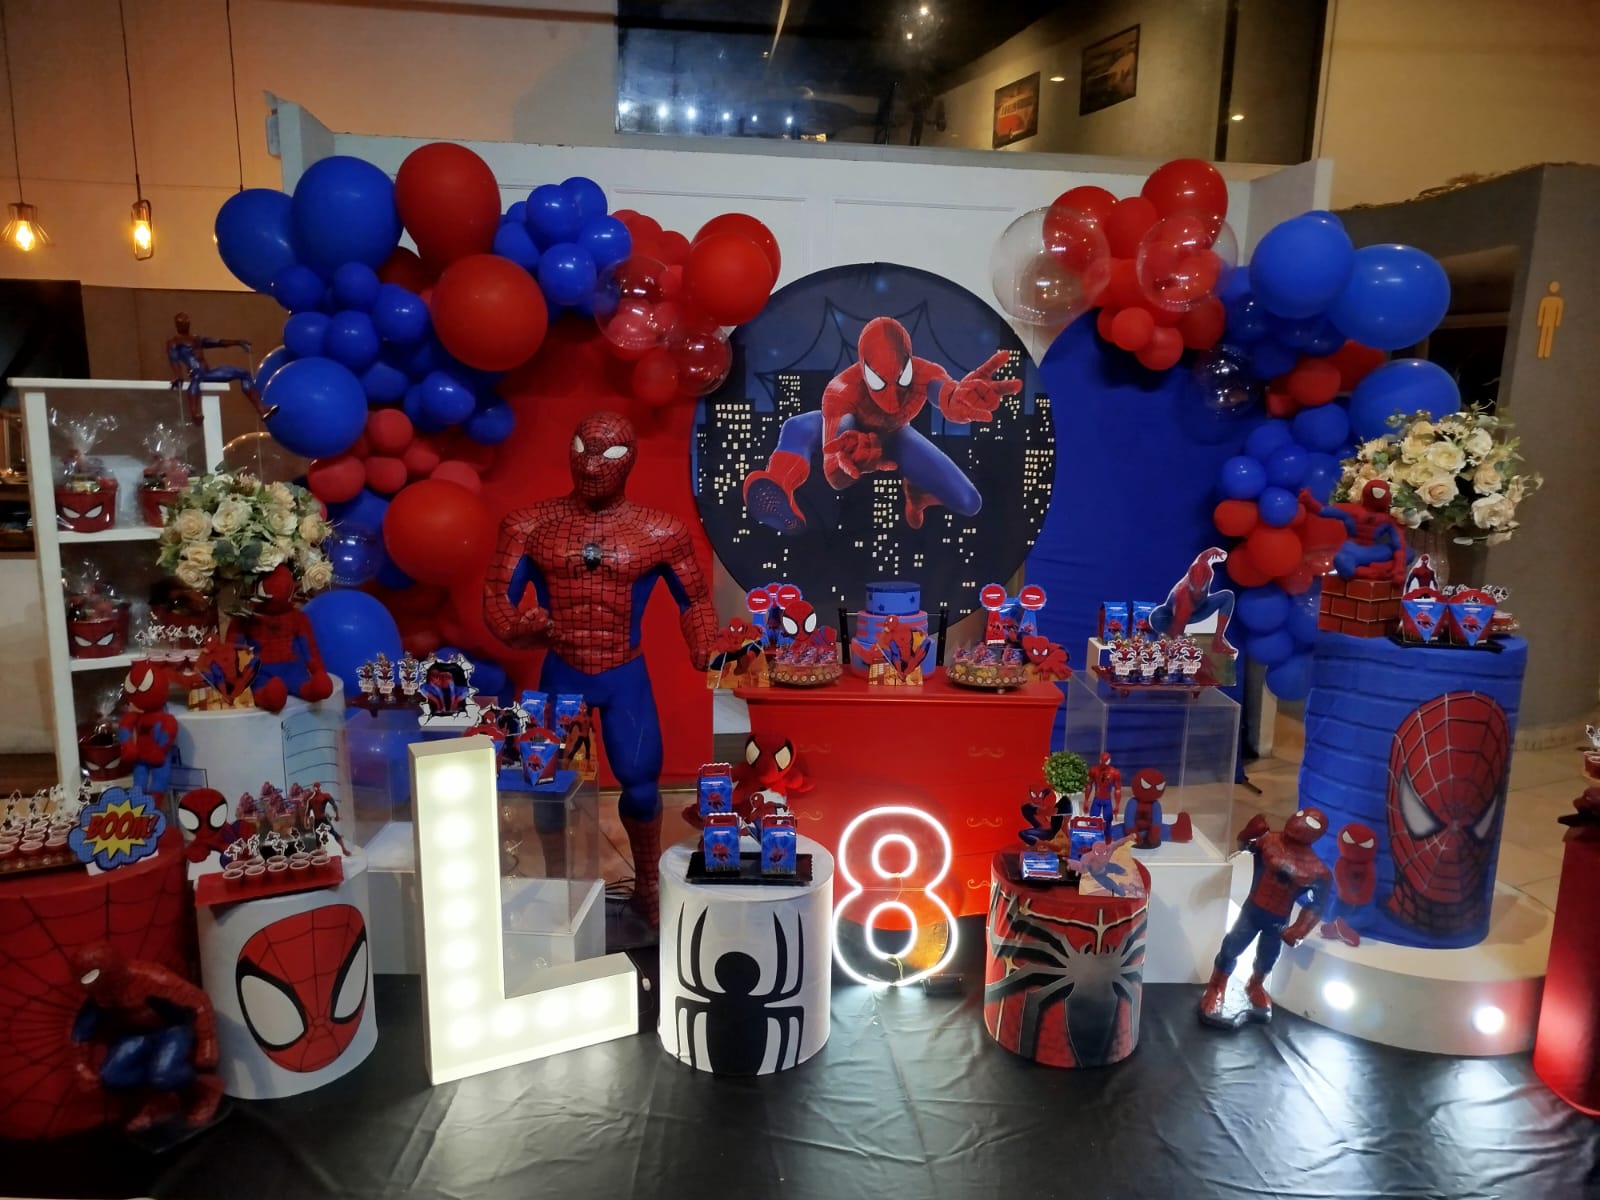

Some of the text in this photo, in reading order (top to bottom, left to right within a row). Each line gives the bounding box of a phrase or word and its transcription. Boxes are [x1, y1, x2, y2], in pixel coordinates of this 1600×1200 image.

[86, 811, 159, 841] BOOM!
[410, 736, 639, 1086] L
[832, 806, 958, 986] 8
